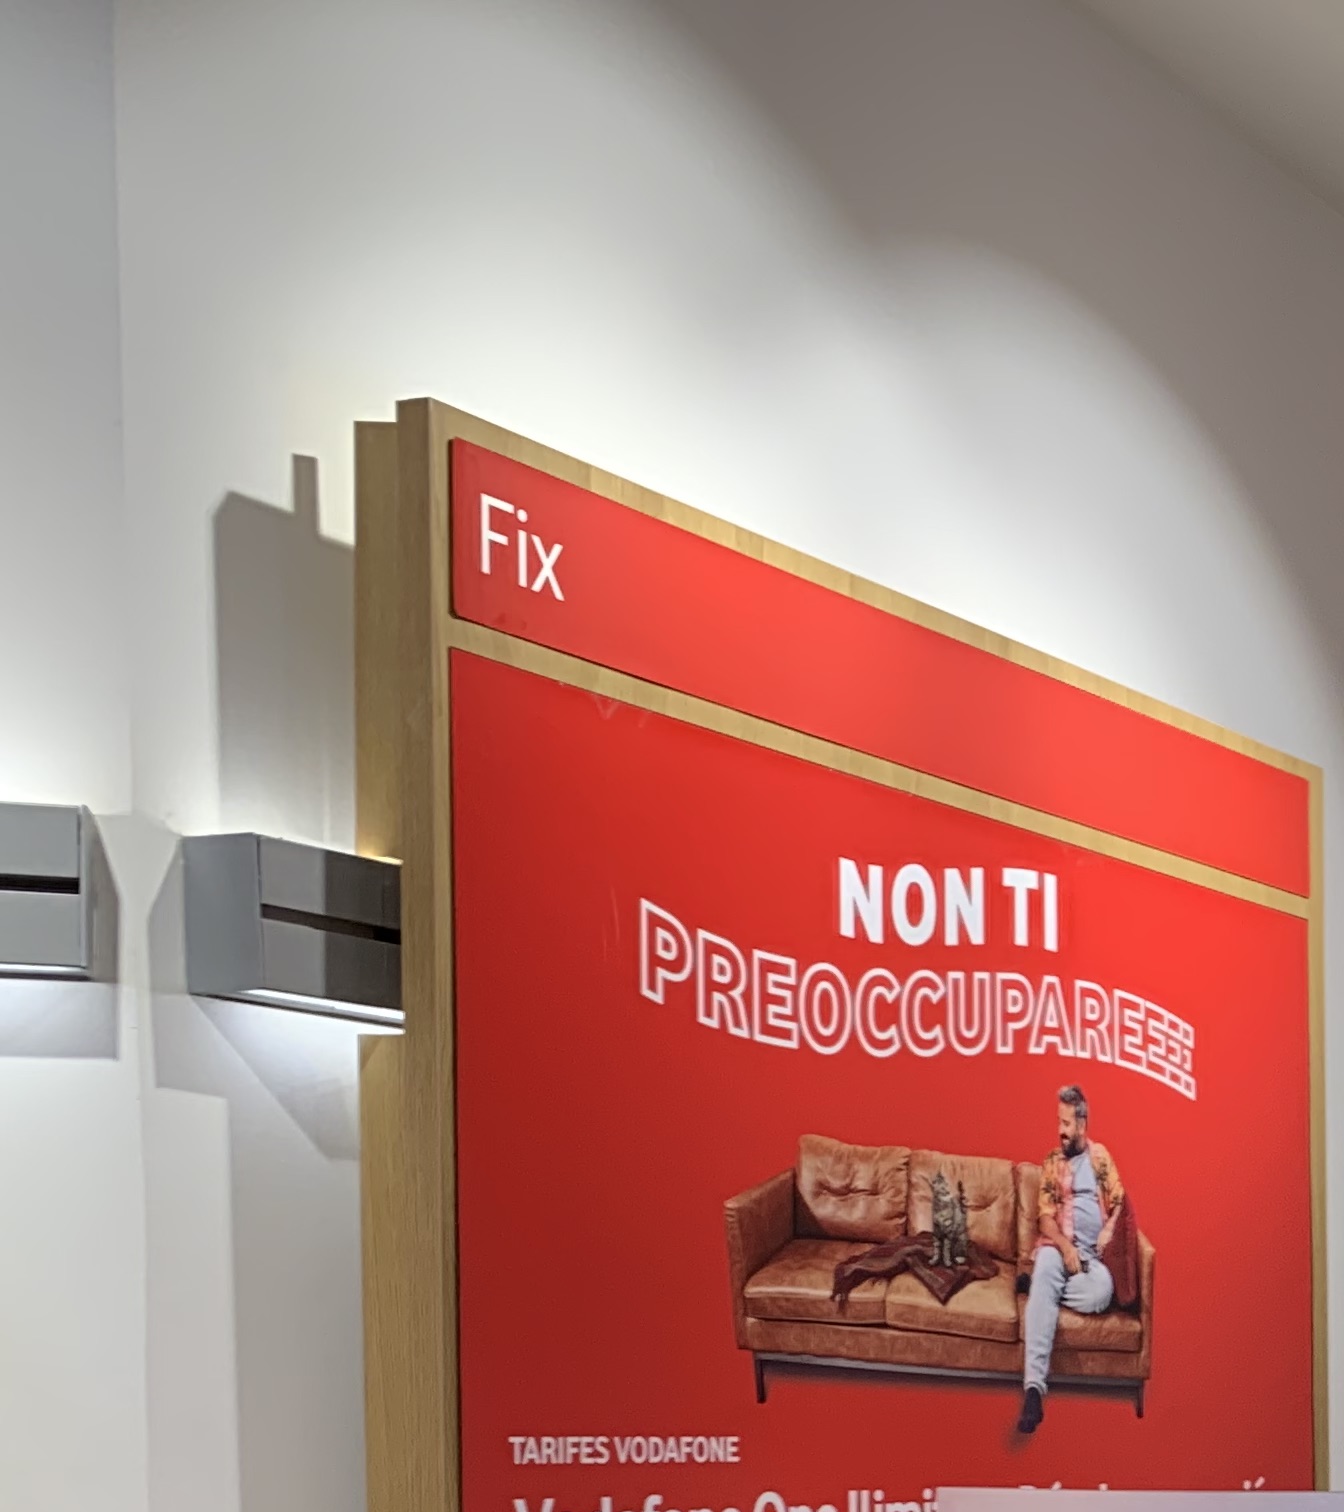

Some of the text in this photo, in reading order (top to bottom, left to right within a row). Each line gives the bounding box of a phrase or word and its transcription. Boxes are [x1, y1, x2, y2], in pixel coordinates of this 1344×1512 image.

[480, 493, 565, 601] Fix
[838, 856, 1058, 952] NON TI
[508, 1435, 741, 1465] TARIFES VODAFONE
